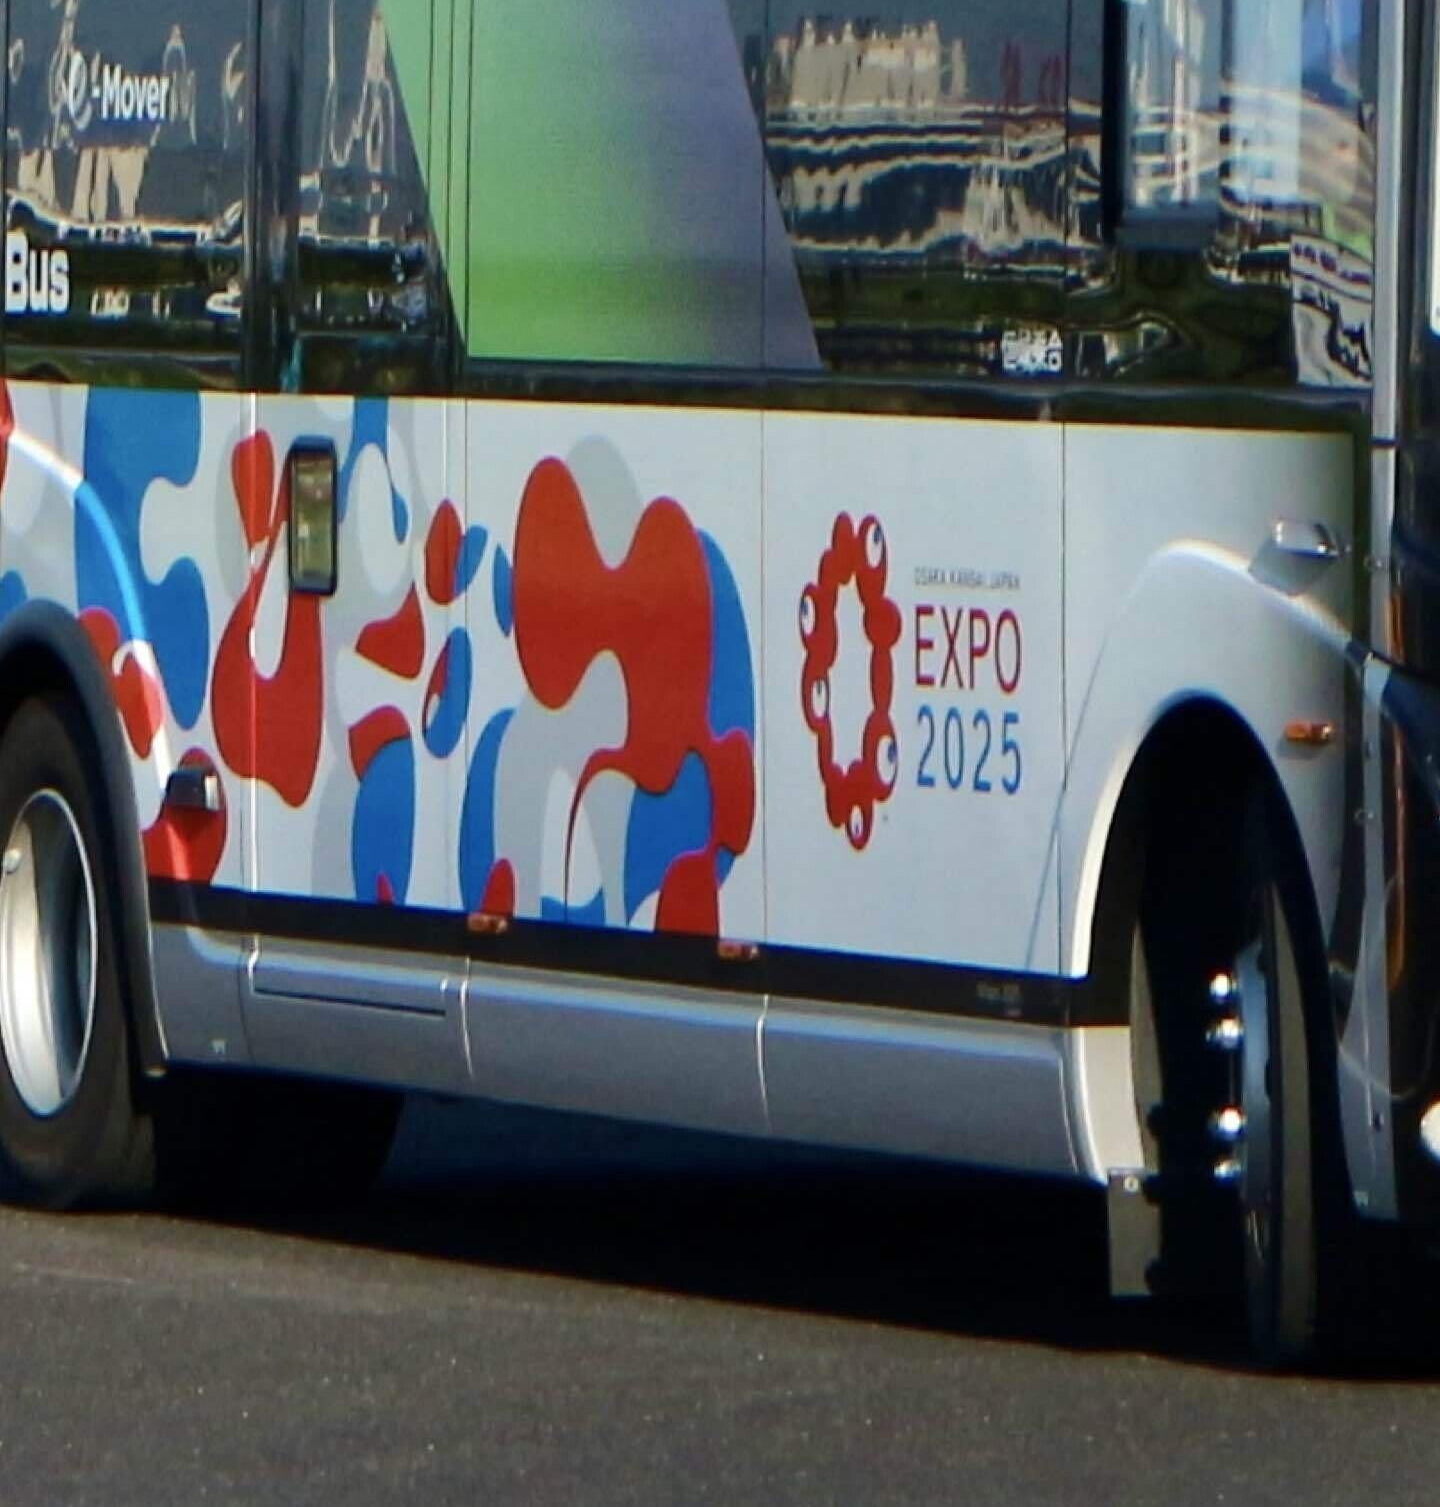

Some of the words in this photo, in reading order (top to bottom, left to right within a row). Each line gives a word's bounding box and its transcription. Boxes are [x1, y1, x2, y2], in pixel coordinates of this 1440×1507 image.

[4, 231, 70, 315] Bus
[914, 605, 1021, 695] EXPO
[915, 705, 1022, 796] 2025
